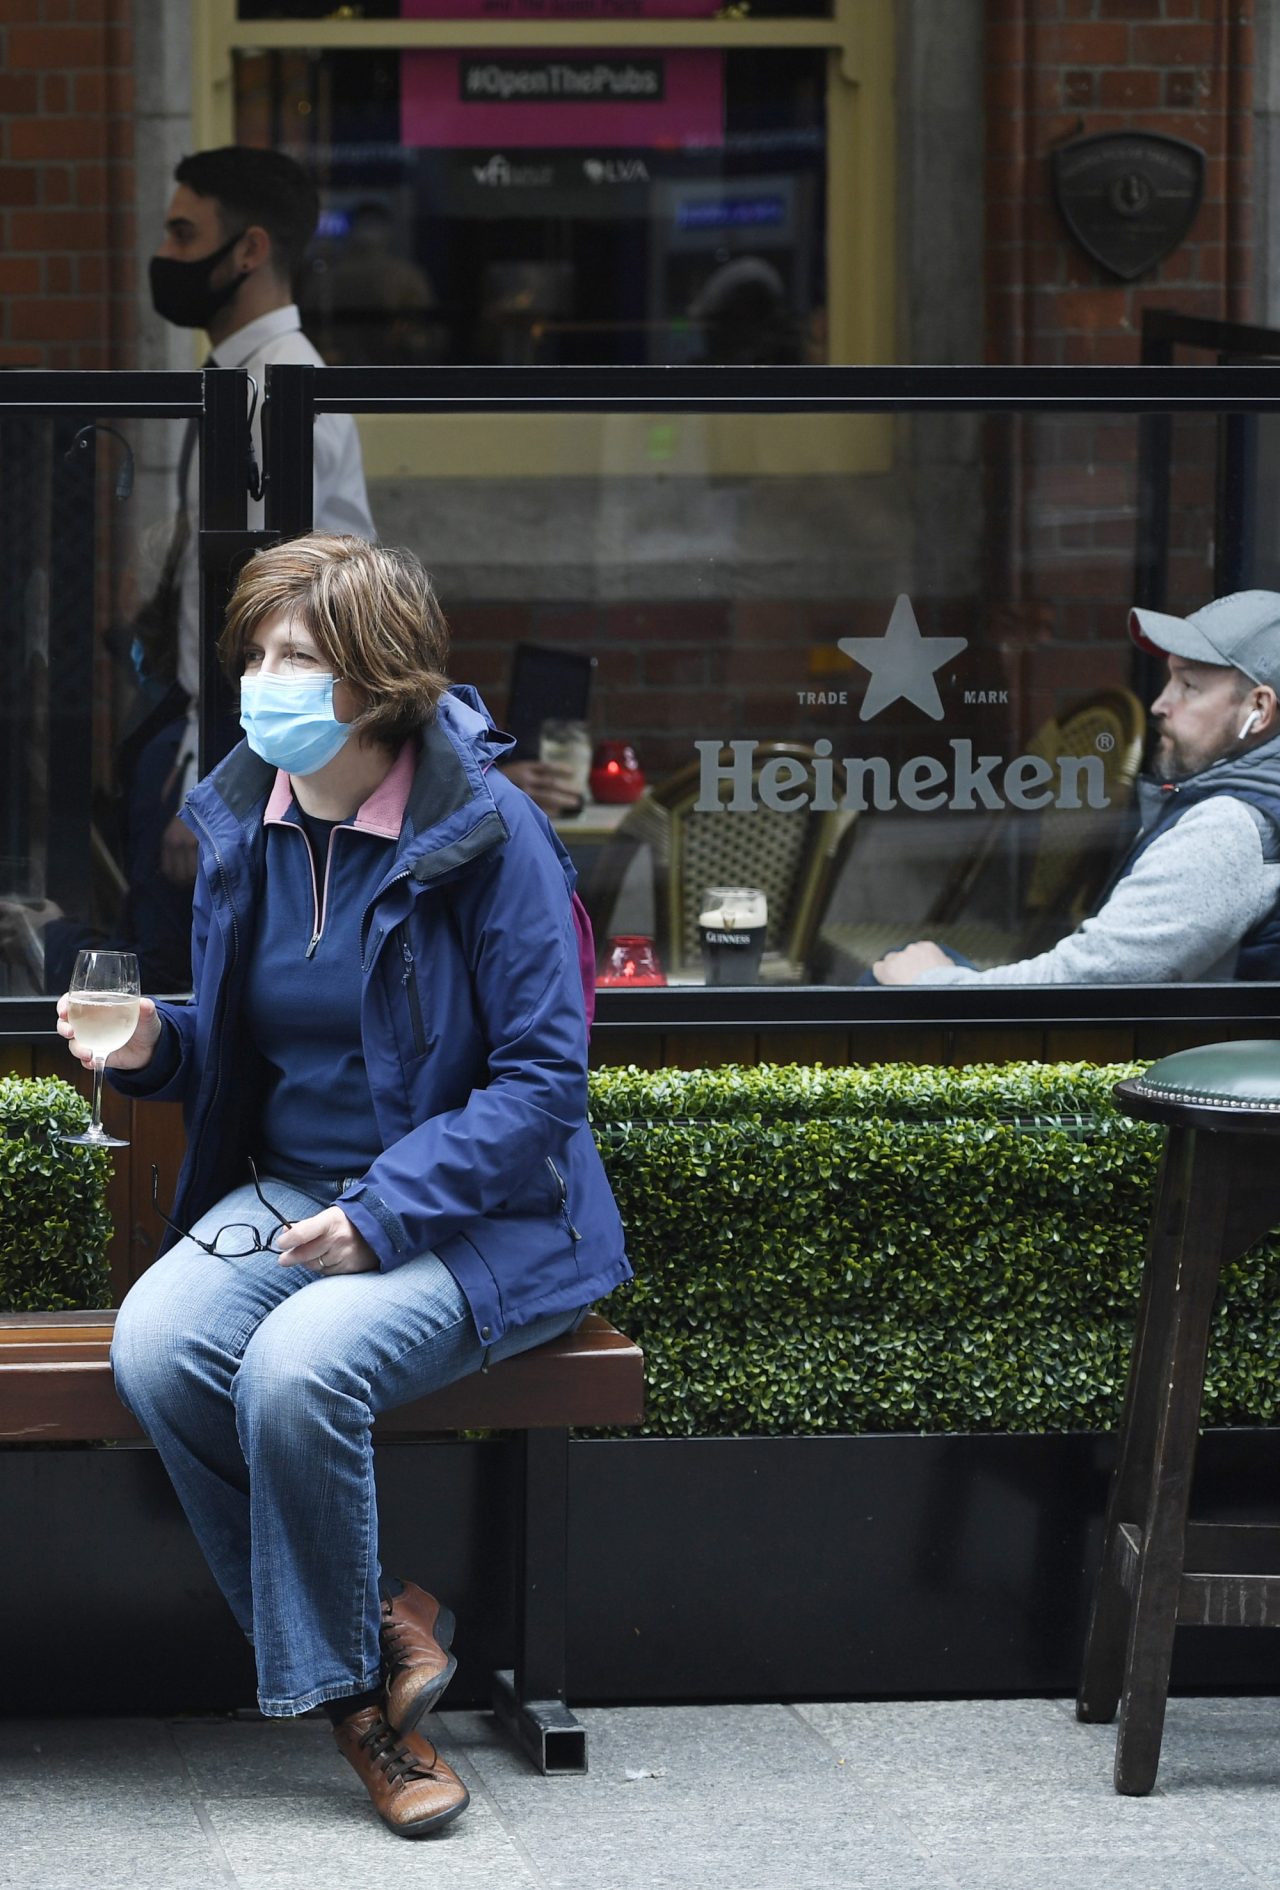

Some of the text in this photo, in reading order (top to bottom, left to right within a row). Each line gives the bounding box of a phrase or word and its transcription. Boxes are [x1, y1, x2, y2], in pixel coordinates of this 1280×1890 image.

[467, 64, 658, 98] #OpenThePubs
[797, 690, 1009, 705] TRADE MARK
[705, 931, 751, 945] GUINNESS
